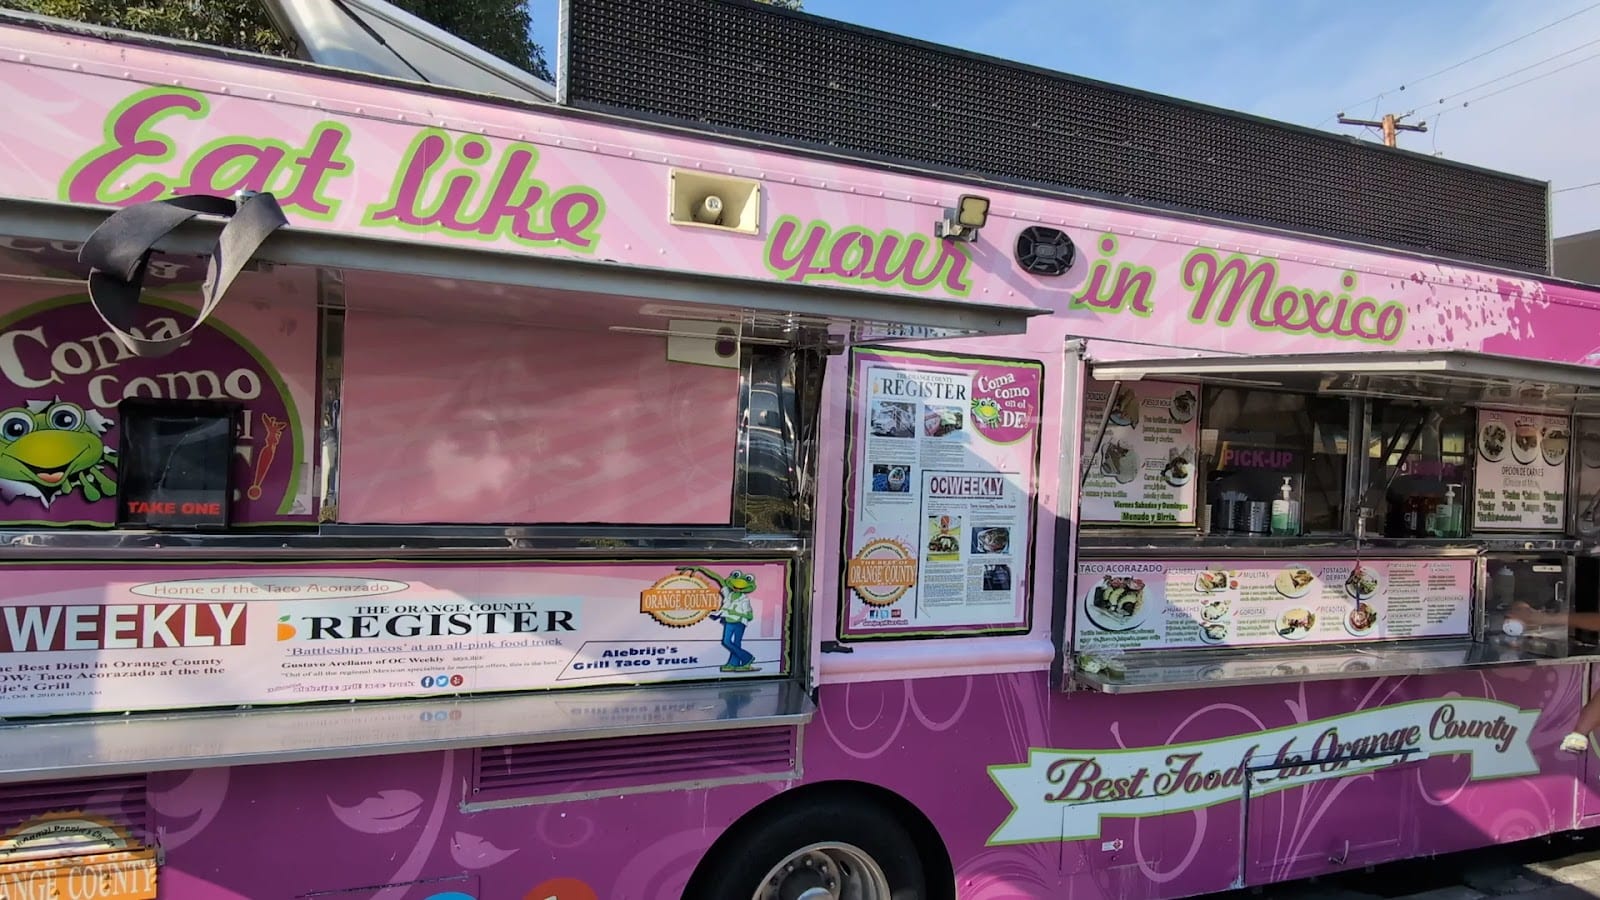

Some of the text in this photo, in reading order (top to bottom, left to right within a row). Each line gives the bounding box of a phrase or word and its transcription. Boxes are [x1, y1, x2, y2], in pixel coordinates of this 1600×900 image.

[60, 87, 1406, 345] Eat like your in Mexico
[88, 368, 261, 408] como
[881, 378, 966, 401] REGISTER
[978, 372, 1015, 392] Coma
[995, 387, 1030, 399] como
[1224, 449, 1292, 467] PICK-UP
[128, 502, 221, 515] TAKE ONE
[1123, 512, 1149, 521] Menudo
[1150, 513, 1155, 522] y
[850, 565, 914, 583] ORANGE COUNTY
[1080, 564, 1162, 573] TACO ACORAZADO
[155, 583, 390, 595] Home of the Taco Acorazado
[645, 592, 719, 609] ORANGE COUNTY
[355, 602, 535, 615] THE ORANGE COUNTY
[3, 603, 246, 651] WEEKLY
[302, 610, 577, 641] REGISTER
[287, 646, 364, 656] 'Battleship
[368, 643, 407, 653] tacos'
[411, 643, 424, 651] at
[447, 640, 497, 650] all-pink
[500, 639, 528, 648] food
[532, 638, 563, 647] truck
[602, 646, 678, 658] Alebrije's
[18, 663, 50, 672] Best
[56, 662, 89, 670] Dish
[113, 660, 167, 669] Orange
[172, 658, 223, 667] County
[329, 660, 372, 668] Arellano
[409, 656, 444, 664] Weekly
[573, 656, 698, 670] Grill Taco Truck
[39, 673, 73, 681] Taco
[77, 669, 155, 679] Acorazado
[178, 668, 200, 676] the
[204, 667, 225, 675] the
[34, 682, 70, 690] Grill
[1044, 757, 1149, 803] Best
[1154, 745, 1259, 796] Food
[1310, 724, 1422, 772] Orange
[1428, 703, 1519, 753] County
[68, 860, 153, 899] COUNTY
